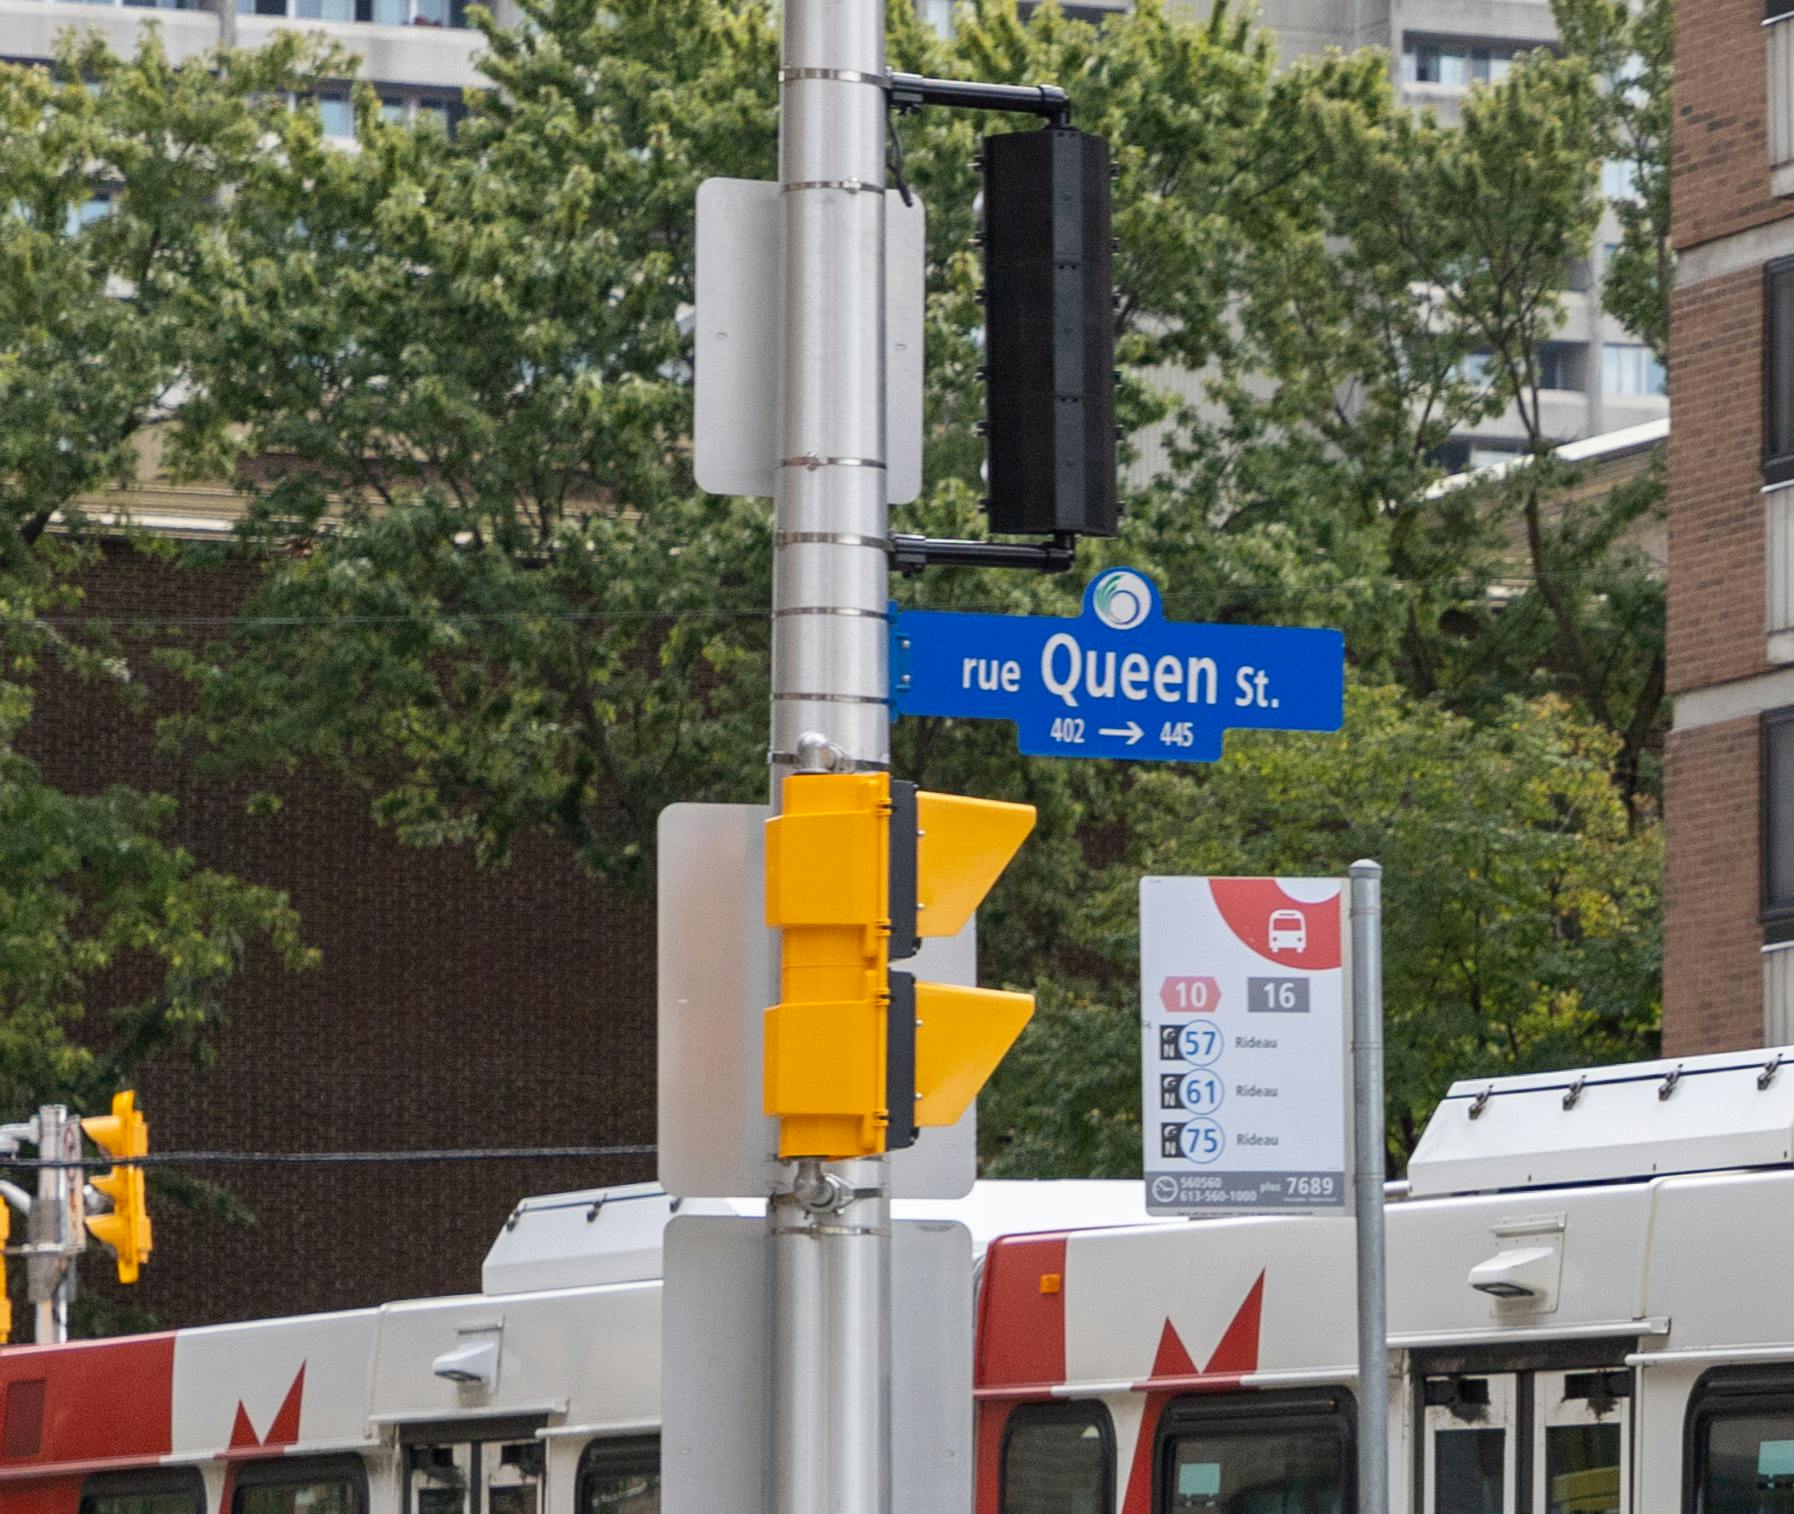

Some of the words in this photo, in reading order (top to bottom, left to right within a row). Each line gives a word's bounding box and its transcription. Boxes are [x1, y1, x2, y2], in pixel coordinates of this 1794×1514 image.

[962, 656, 1021, 693] rue
[1040, 632, 1218, 707] Queen
[1234, 665, 1280, 709] St.
[1050, 717, 1086, 744] 402
[1160, 721, 1194, 748] 445
[1175, 981, 1208, 1008] 10
[1263, 982, 1296, 1009] 16
[1185, 1031, 1216, 1056] 57
[1235, 1036, 1278, 1049] Rideau
[1186, 1080, 1216, 1104] 61
[1236, 1085, 1279, 1097] Rideau
[1186, 1129, 1217, 1153] 75
[1237, 1133, 1279, 1146] Rideau
[1285, 1177, 1333, 1195] 7689
